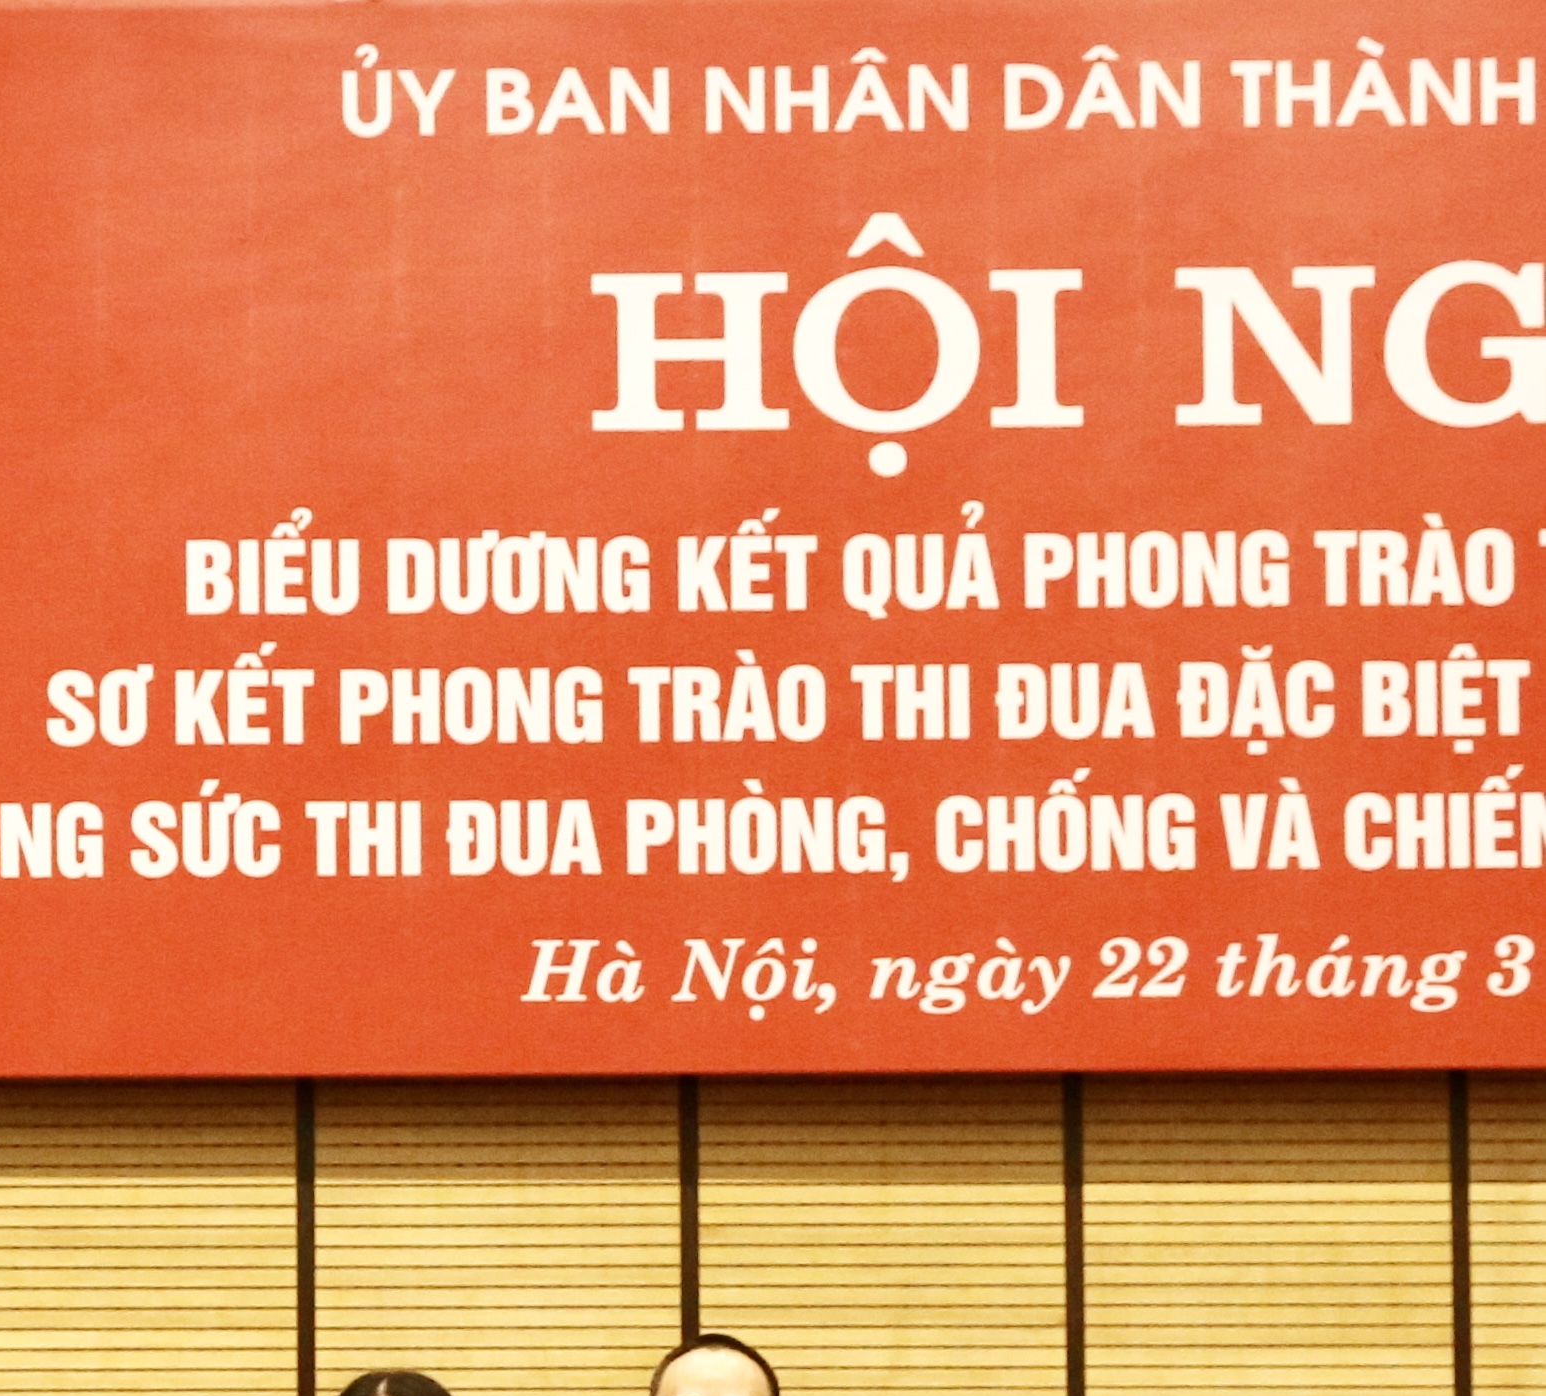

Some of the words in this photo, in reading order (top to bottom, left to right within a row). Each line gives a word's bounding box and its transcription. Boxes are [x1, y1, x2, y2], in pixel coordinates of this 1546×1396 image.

[342, 44, 455, 139] ỦY
[486, 67, 669, 136] BAN
[706, 48, 968, 134] NHÂN
[1004, 45, 1201, 131] DÂN
[1230, 36, 1537, 128] THÀNH
[591, 213, 1084, 477] HỘI
[1175, 259, 1546, 428] NG
[186, 508, 359, 615] BIỂU
[388, 530, 650, 614] DƯƠNG
[678, 508, 817, 612] KẾT
[843, 501, 999, 618] QUẢ
[1025, 530, 1289, 609] PHONG
[1314, 513, 1514, 607] TRÀO
[47, 664, 153, 747] SƠ
[176, 642, 314, 745] KẾT
[340, 667, 602, 745] PHONG
[628, 650, 825, 743] TRÀO
[851, 664, 970, 741] THI
[995, 663, 1155, 740] ĐUA
[1177, 645, 1334, 754] ĐẶC
[1362, 643, 1530, 753] BIỆT
[131, 779, 281, 878] SỨC
[306, 801, 421, 877] THI
[446, 800, 601, 876] ĐUA
[627, 779, 908, 881] PHÒNG,
[936, 767, 1195, 872] CHỐNG
[1220, 778, 1320, 870] VÀ
[521, 940, 644, 1003] Hà
[672, 938, 836, 1020] Nội,
[870, 938, 1070, 1015] ngày
[1093, 937, 1188, 998] 22
[1217, 934, 1467, 1012] tháng
[1487, 935, 1535, 996] 3
